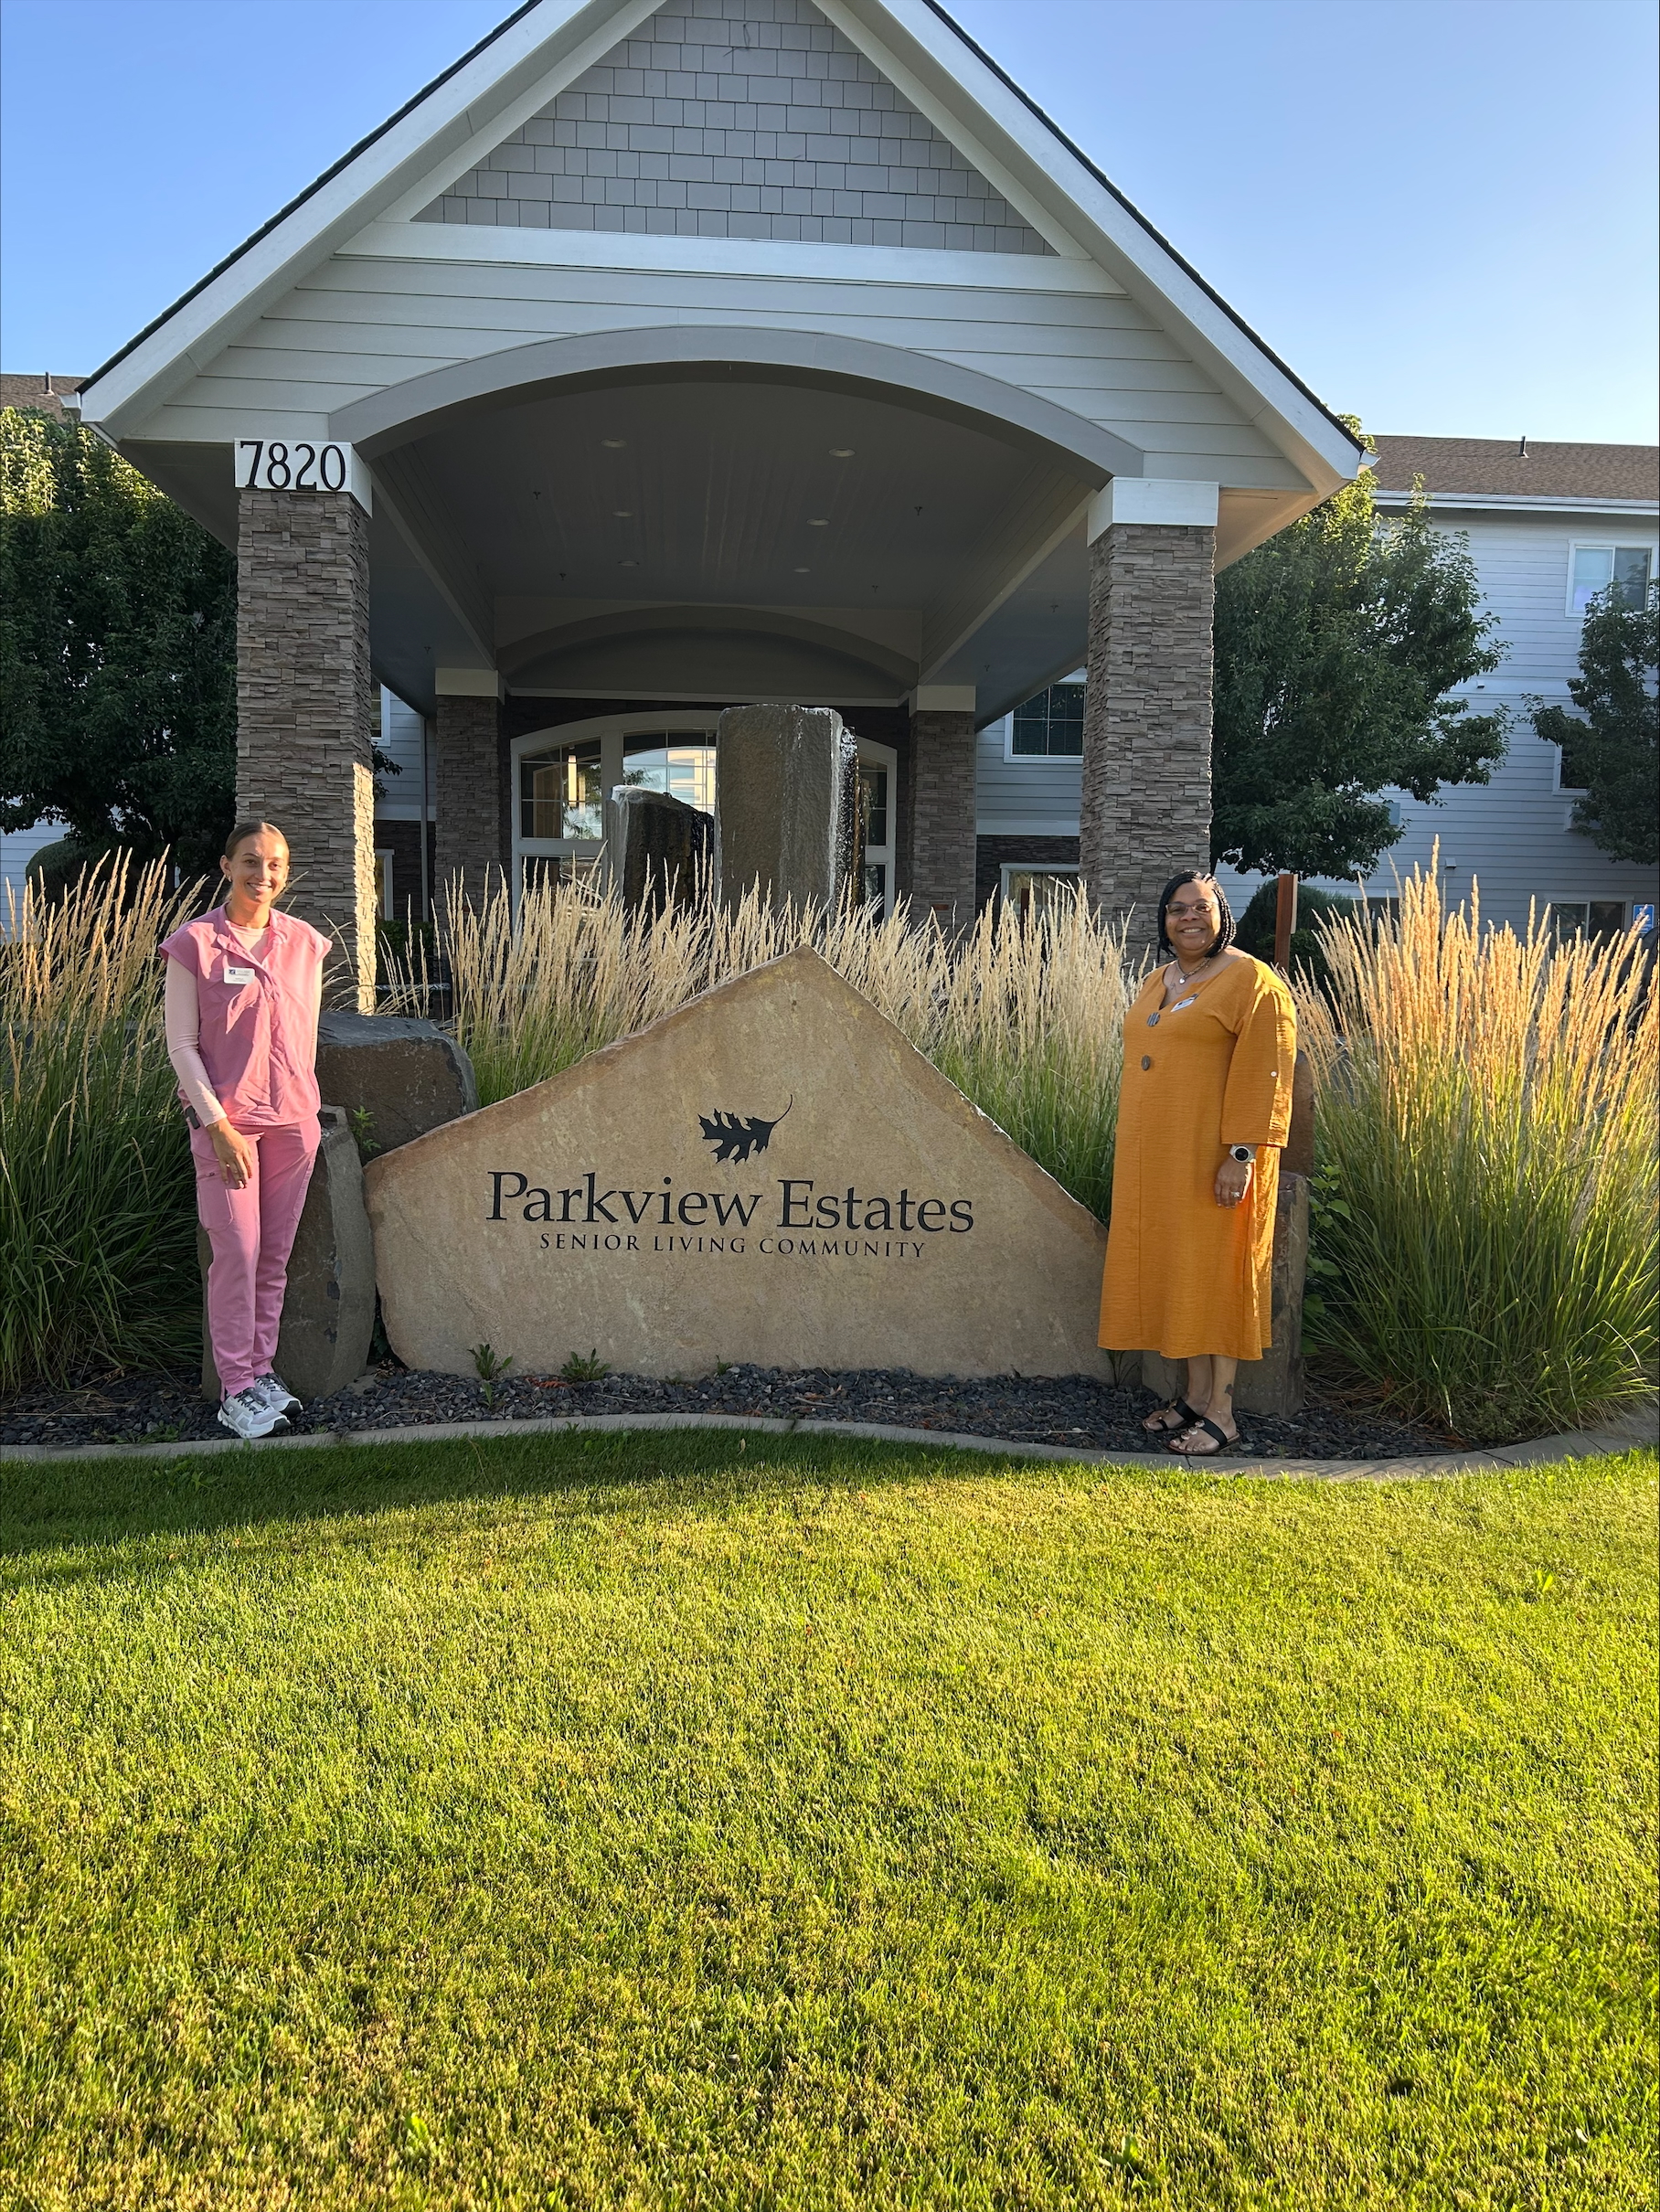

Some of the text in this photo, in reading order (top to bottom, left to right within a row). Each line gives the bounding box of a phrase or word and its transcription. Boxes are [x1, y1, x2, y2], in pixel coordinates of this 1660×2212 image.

[239, 441, 346, 491] 7820
[485, 1171, 974, 1233] Parkview Estates
[539, 1232, 926, 1258] SENIOR LIVING COMMUNITY
